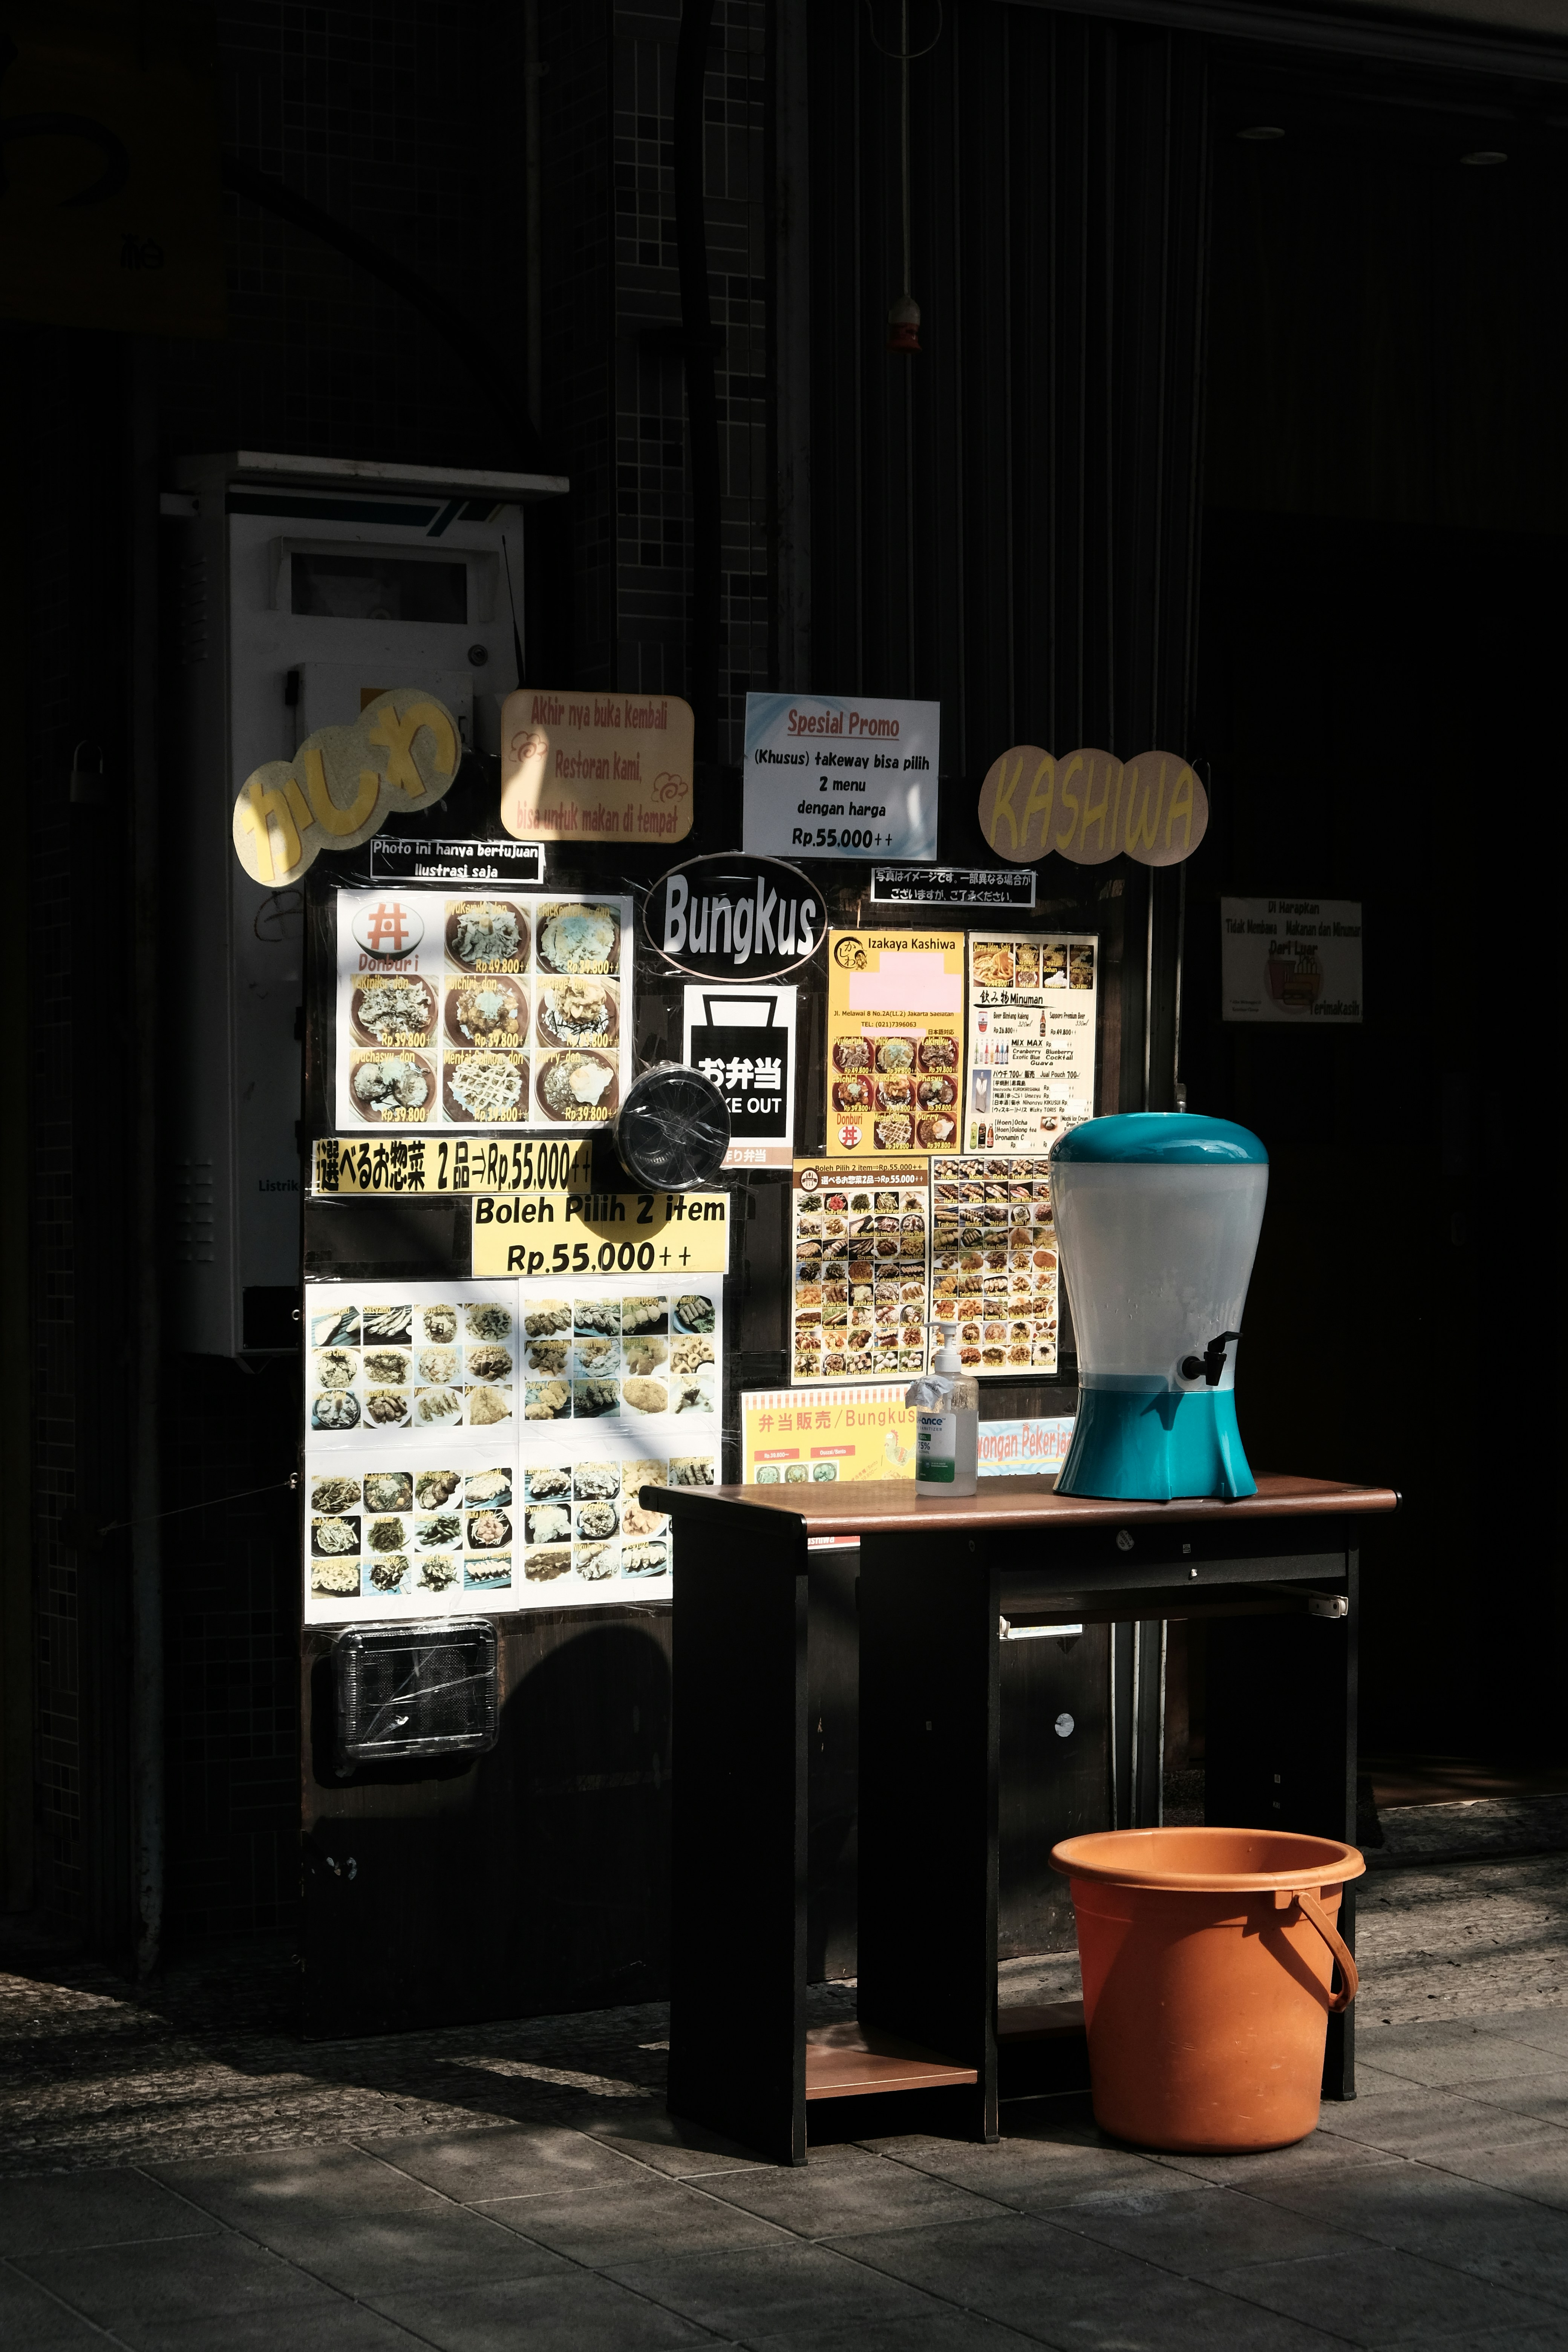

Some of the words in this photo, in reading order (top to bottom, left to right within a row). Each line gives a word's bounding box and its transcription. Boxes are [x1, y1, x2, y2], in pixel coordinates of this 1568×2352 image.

[531, 695, 565, 725] Akhir
[569, 704, 590, 730] nya
[788, 709, 844, 735] Spesial
[849, 712, 899, 737] Promo
[555, 749, 609, 779] Restoran
[755, 749, 810, 766] (Khusus)
[815, 752, 869, 769] takeway
[874, 754, 899, 769] bisa
[903, 756, 929, 771] pilih
[243, 701, 457, 882] かしわ
[819, 776, 828, 791] 2
[833, 780, 866, 792] menu
[798, 800, 844, 816] dengan
[849, 802, 886, 818] harga
[989, 756, 1195, 853] KASHIWA
[517, 800, 540, 829] bisa
[544, 802, 578, 830] untuk
[582, 803, 619, 831] makan
[623, 804, 633, 832] di
[637, 804, 678, 837] tempat
[374, 841, 411, 854] Photo
[416, 842, 431, 854] ini
[436, 842, 473, 858] hanya
[477, 844, 537, 859] bertujuan
[472, 865, 498, 879] saja
[876, 870, 1031, 886] 写真はイメージです。一部異なる場合が
[891, 888, 1012, 903] ございますが、ご了承ください。
[1279, 901, 1319, 915] Harapkan
[663, 873, 816, 964] Bungkus
[1226, 918, 1245, 934] Tidak
[1247, 919, 1277, 935] Membawa
[1286, 920, 1317, 936] Makanan
[1318, 921, 1331, 936] dan
[868, 937, 908, 951] Izakaya
[911, 938, 956, 949] Kashiwa
[1295, 941, 1318, 956] Luar
[358, 953, 419, 972] Donburi
[839, 941, 856, 966] かしわ
[1010, 993, 1043, 1004] Minuman
[698, 1057, 782, 1090] お弁当
[747, 1098, 782, 1113] OUT
[837, 1113, 862, 1125] Donburi
[916, 1113, 939, 1121] Curry
[317, 1140, 425, 1191] 選べるお惣菜
[259, 1179, 299, 1191] Listrik
[476, 1195, 554, 1224] Boleh
[565, 1194, 625, 1222] Pilih
[637, 1194, 654, 1224] 2
[666, 1194, 725, 1221] item
[918, 1442, 930, 1450] 75%
[978, 1435, 1018, 1462] ongan
[1022, 1423, 1073, 1458] Pekerjaa
